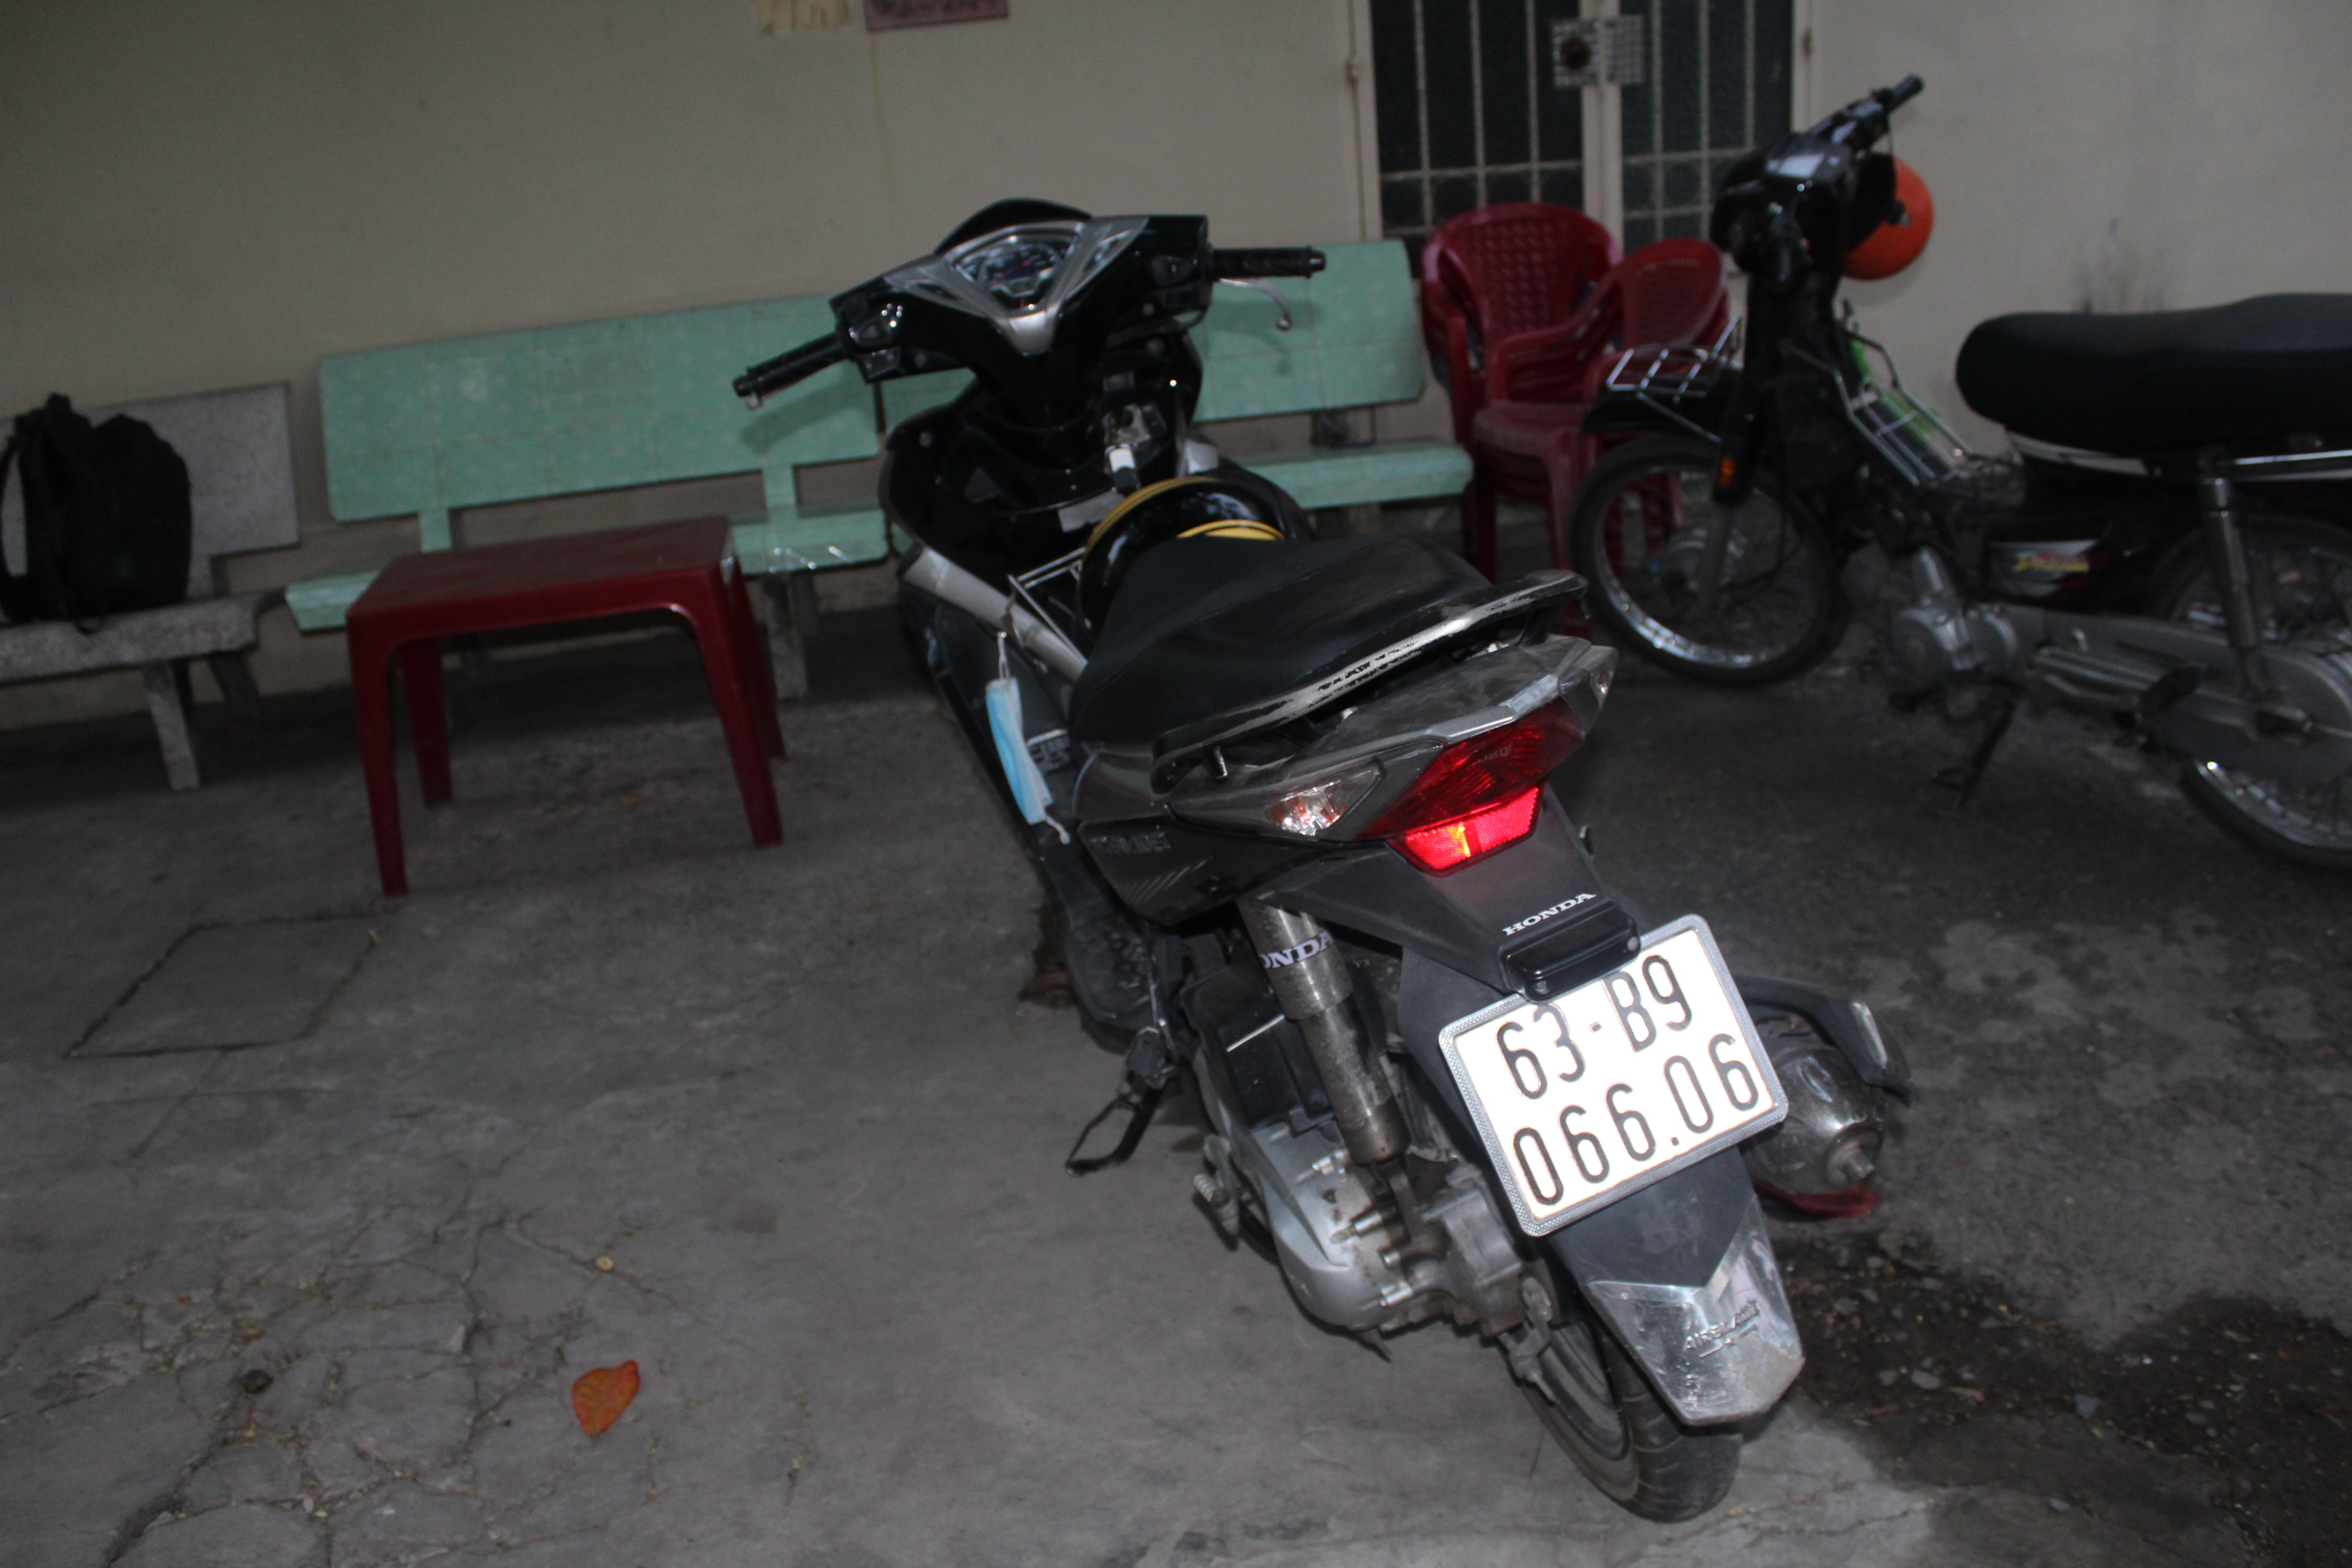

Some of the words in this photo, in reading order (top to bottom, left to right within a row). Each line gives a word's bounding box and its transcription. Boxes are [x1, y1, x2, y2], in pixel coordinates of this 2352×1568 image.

[1502, 893, 1597, 936] HONDA
[1494, 954, 1692, 1100] 63-B9
[1513, 1033, 1759, 1205] 066.06
